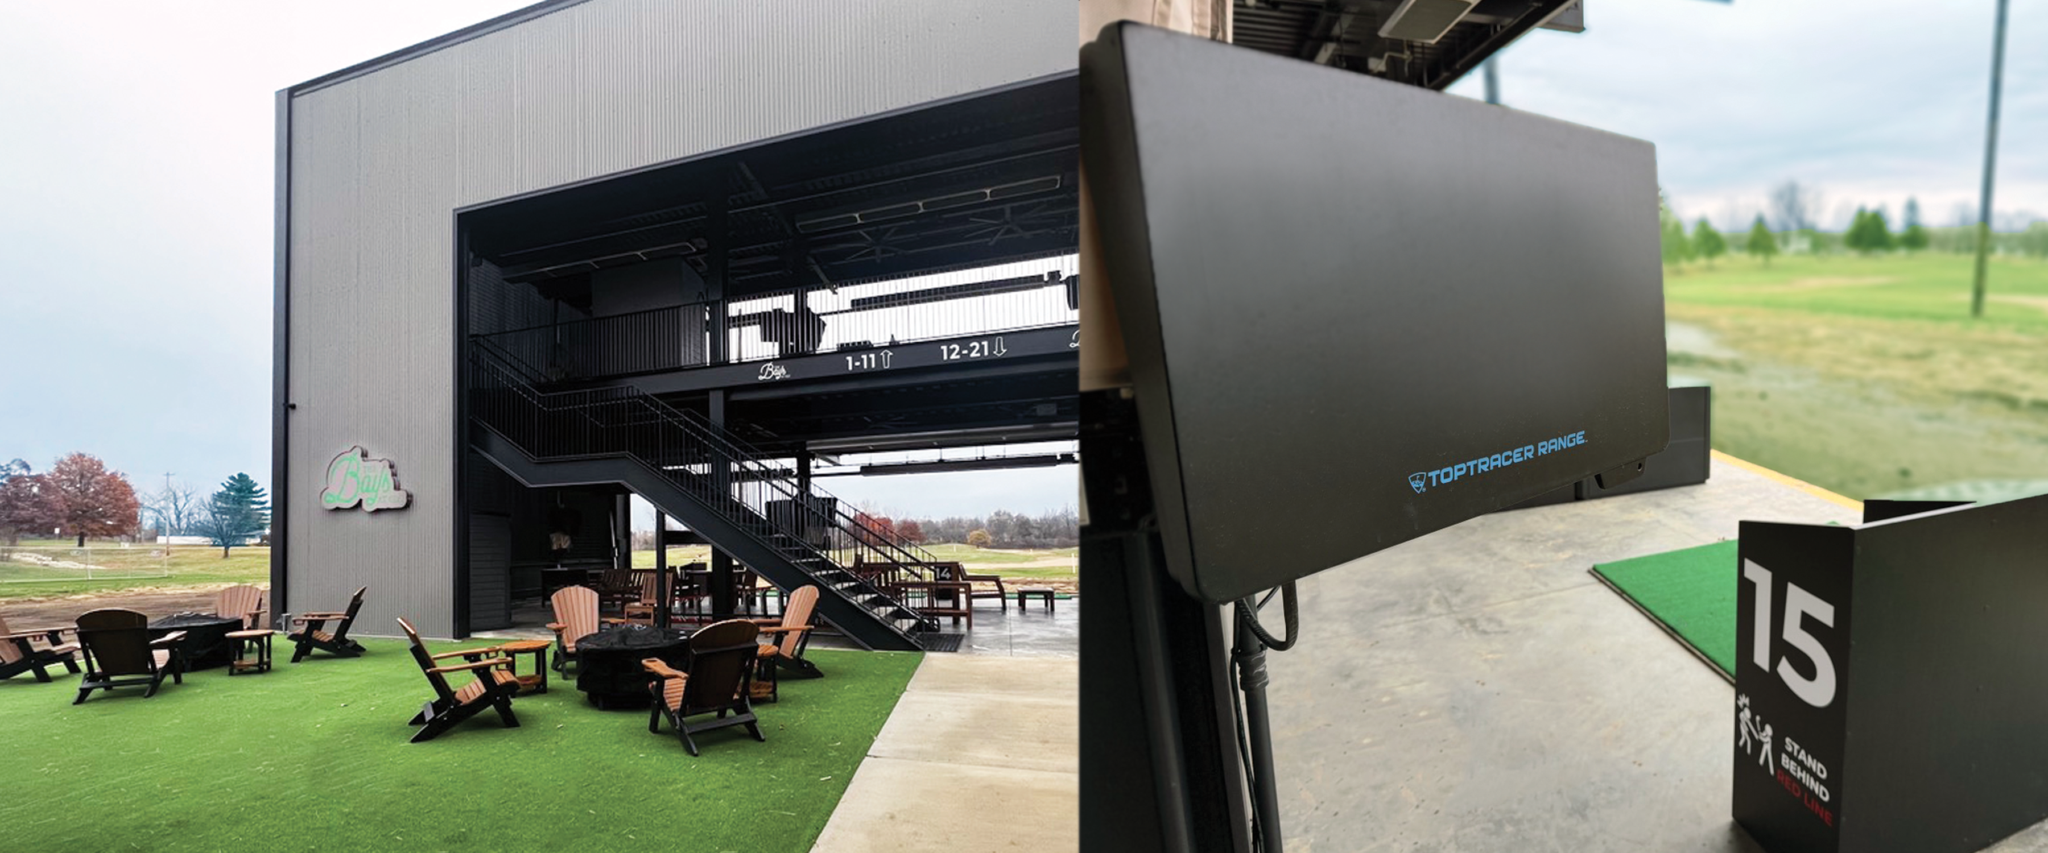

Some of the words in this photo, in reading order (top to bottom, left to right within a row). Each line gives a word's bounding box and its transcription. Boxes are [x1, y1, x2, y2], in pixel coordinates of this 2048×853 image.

[845, 353, 876, 371] 1-11
[940, 341, 989, 361] 12-21
[1428, 445, 1534, 487] TOPTRACER
[935, 567, 951, 580] 14
[1743, 557, 1837, 708] 15
[1780, 752, 1830, 803] BEHIND
[1784, 736, 1828, 780] STAND
[1776, 769, 1801, 798] RED
[1803, 792, 1834, 827] LINE
